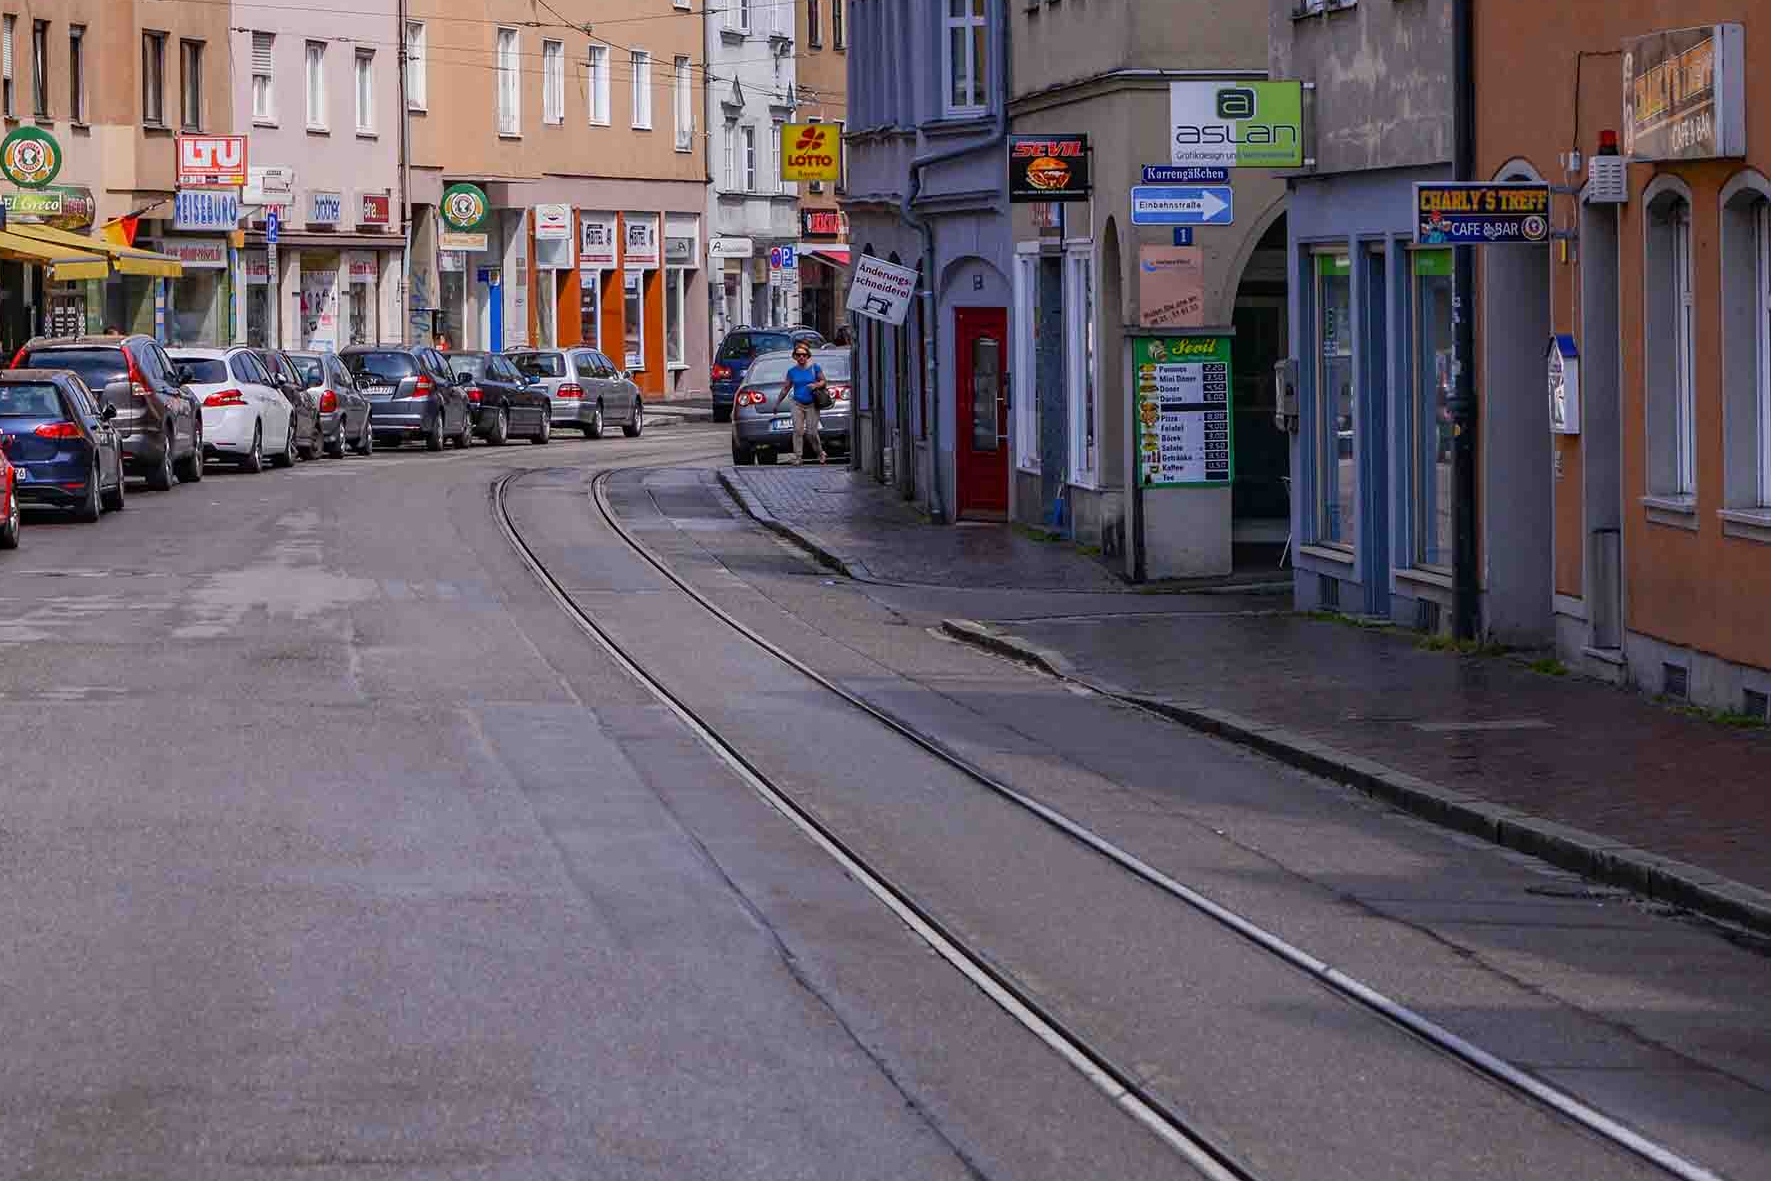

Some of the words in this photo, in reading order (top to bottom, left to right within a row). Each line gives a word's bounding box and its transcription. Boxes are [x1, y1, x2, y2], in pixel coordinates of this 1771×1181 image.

[183, 139, 241, 167] LTU
[787, 154, 833, 167] LOTTO
[1147, 167, 1224, 181] Karrengäßchen
[20, 195, 59, 211] Greco
[315, 195, 341, 220] brother
[1139, 201, 1201, 209] Einbahnstraße
[1498, 190, 1548, 211] TREFF
[1179, 228, 1187, 243] 1
[1451, 222, 1481, 236] CAFE
[1494, 222, 1519, 236] BAR
[855, 277, 910, 299] schneiderei
